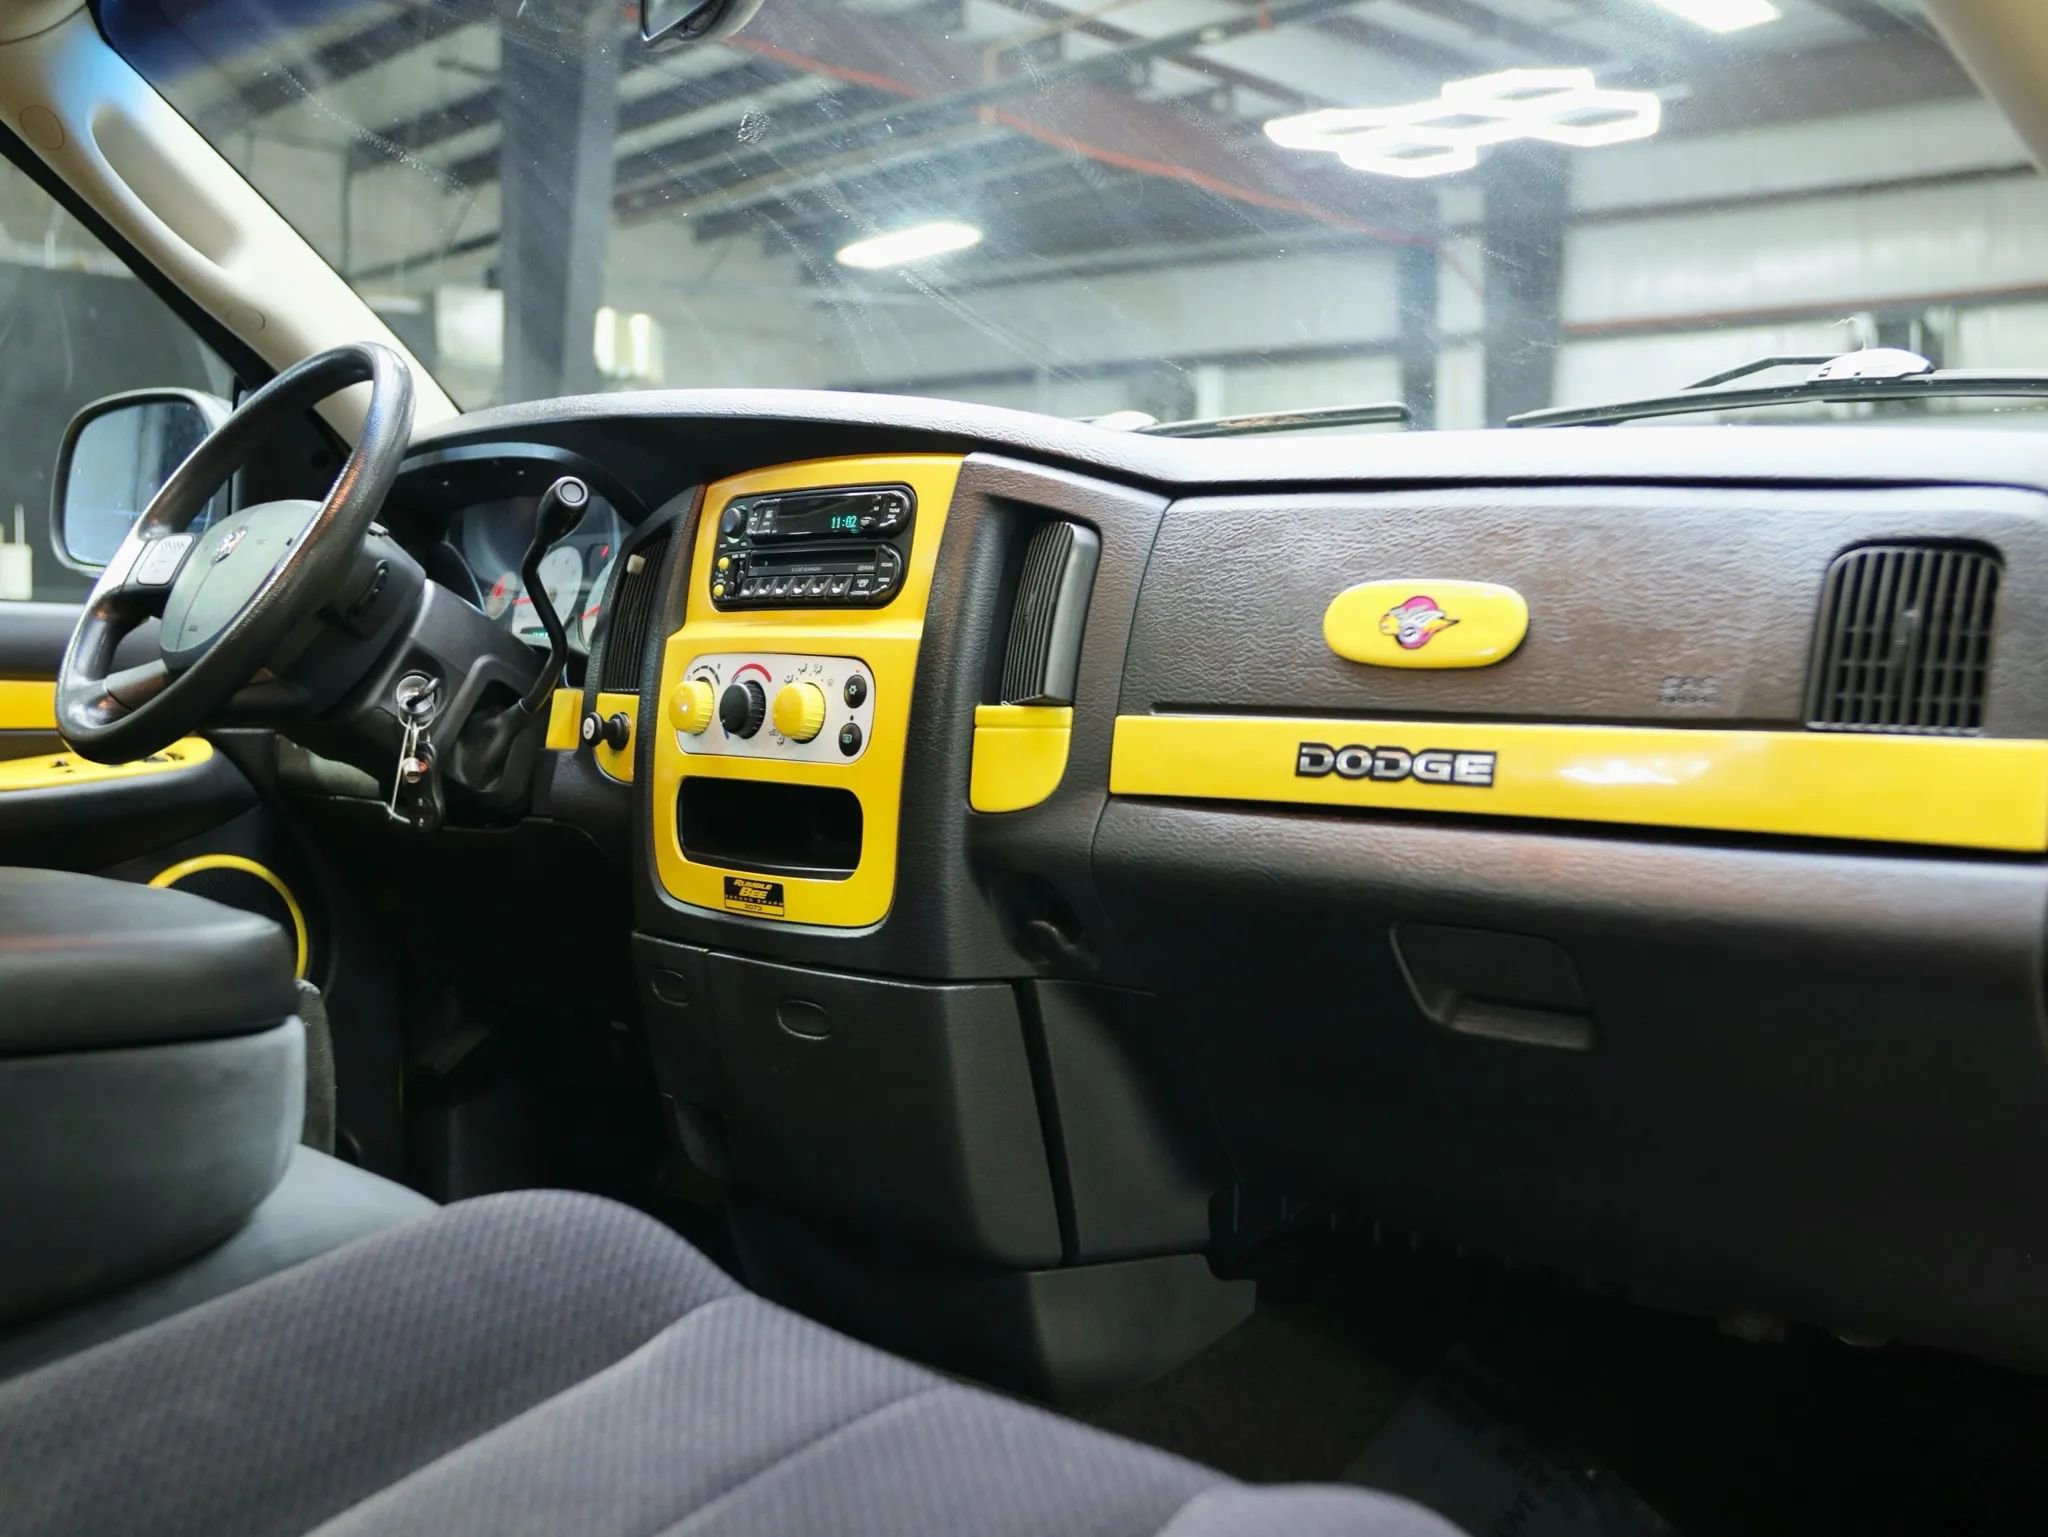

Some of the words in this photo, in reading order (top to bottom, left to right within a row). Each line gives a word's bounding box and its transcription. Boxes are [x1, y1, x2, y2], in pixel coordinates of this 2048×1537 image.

[831, 515, 858, 529] 11:02
[1297, 743, 1496, 787] DODGE
[733, 879, 773, 890] RUMBLE
[738, 887, 768, 899] BEE
